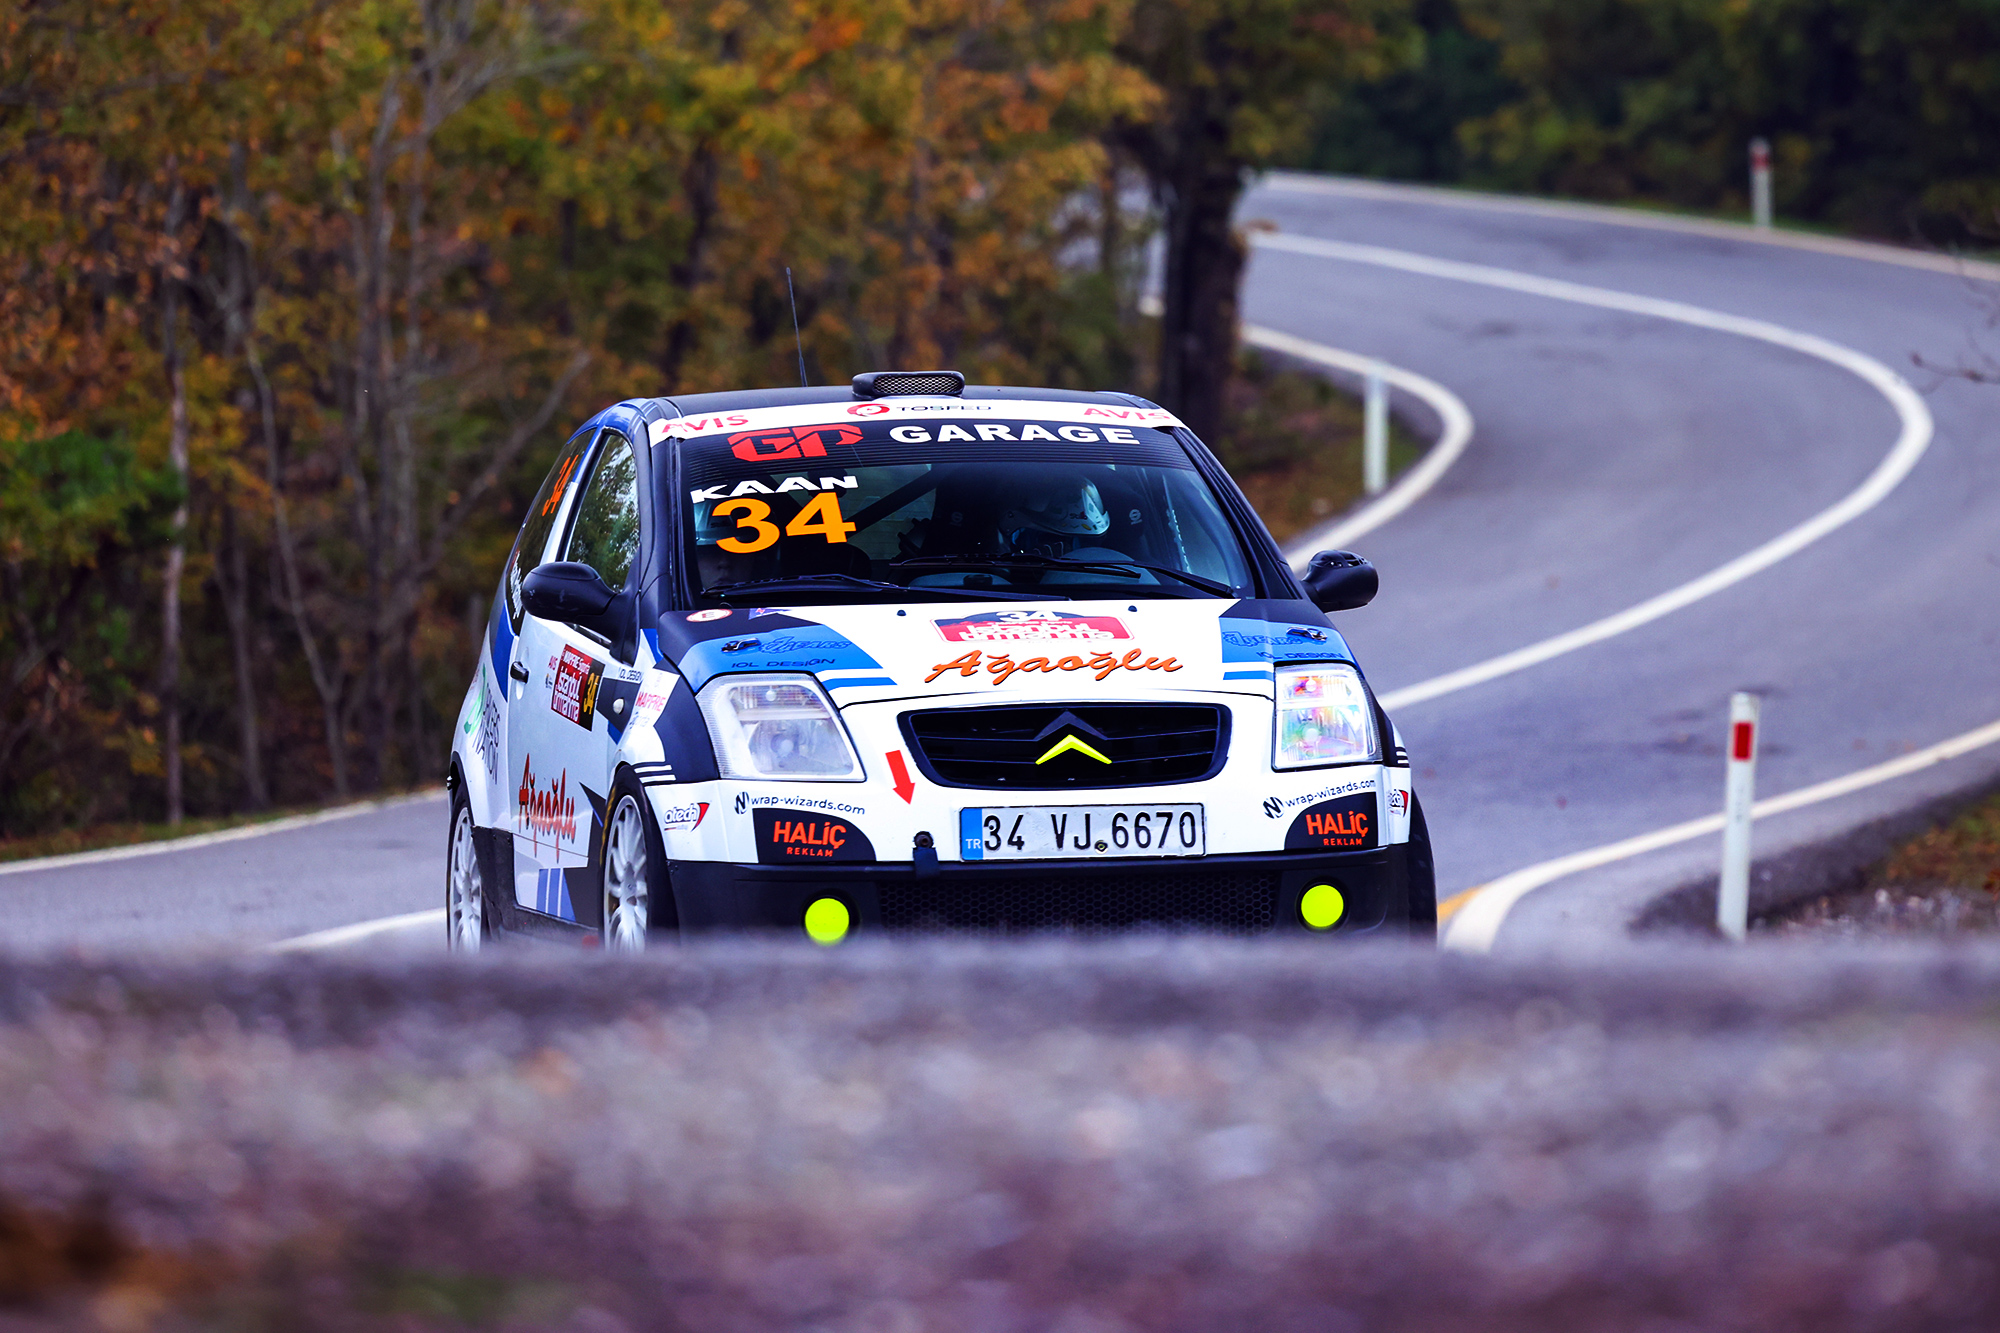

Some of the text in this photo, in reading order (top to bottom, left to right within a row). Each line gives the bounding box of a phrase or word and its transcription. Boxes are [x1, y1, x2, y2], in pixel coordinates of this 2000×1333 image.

[896, 404, 992, 413] TOSFED
[1083, 407, 1171, 421] AVIS
[661, 414, 749, 434] AVIS
[889, 424, 1141, 445] GARAGE
[541, 454, 579, 517] 34
[690, 475, 859, 504] KAAN
[711, 491, 857, 554] 34
[996, 610, 1063, 622] 34
[766, 658, 836, 667] DESIGN
[924, 648, 1184, 686] Ağaoğlu
[583, 673, 600, 715] 34
[635, 691, 667, 712] MAPFRE
[1285, 779, 1377, 807] wrap-wizards.com
[518, 752, 577, 864] Ağaoğlu
[751, 795, 866, 815] wrap-wizards.com
[983, 811, 1197, 851] 34 VJ 6670
[1322, 837, 1363, 846] REKLAM
[786, 846, 834, 857] REKLAM
[965, 838, 982, 850] TR
